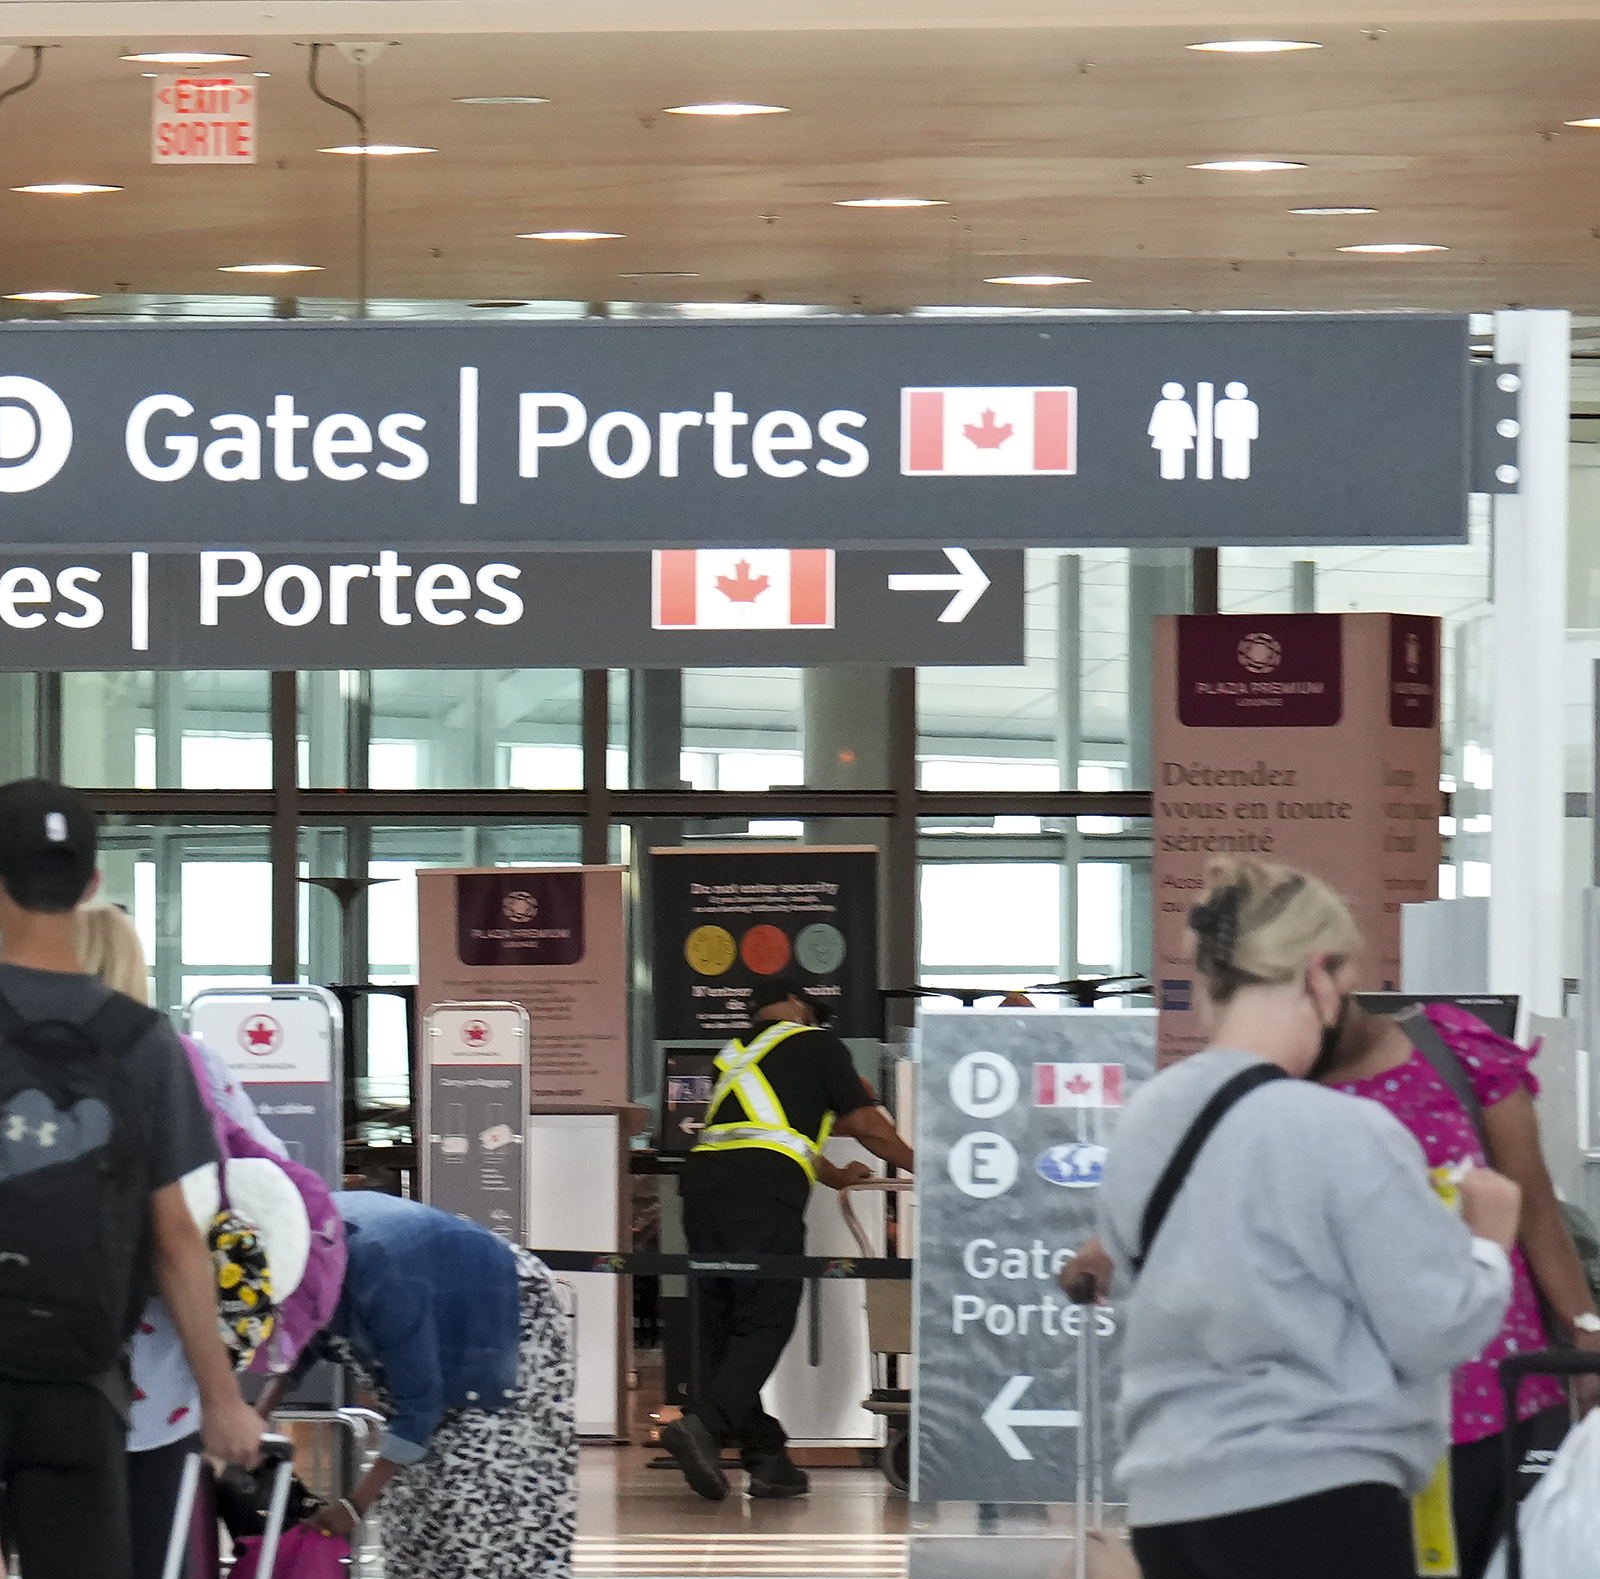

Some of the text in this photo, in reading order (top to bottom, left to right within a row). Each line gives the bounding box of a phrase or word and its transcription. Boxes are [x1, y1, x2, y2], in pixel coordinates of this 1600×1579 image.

[175, 79, 234, 113] EXIT
[157, 122, 250, 156] SORTIE
[125, 393, 429, 482] Gates
[518, 391, 870, 479] Portes
[199, 551, 524, 627] Portes
[1161, 800, 1353, 820] vous en toute
[970, 1062, 1003, 1105] D
[970, 1142, 999, 1185] E
[963, 1238, 1078, 1280] Gate
[952, 1294, 1117, 1337] Portes
